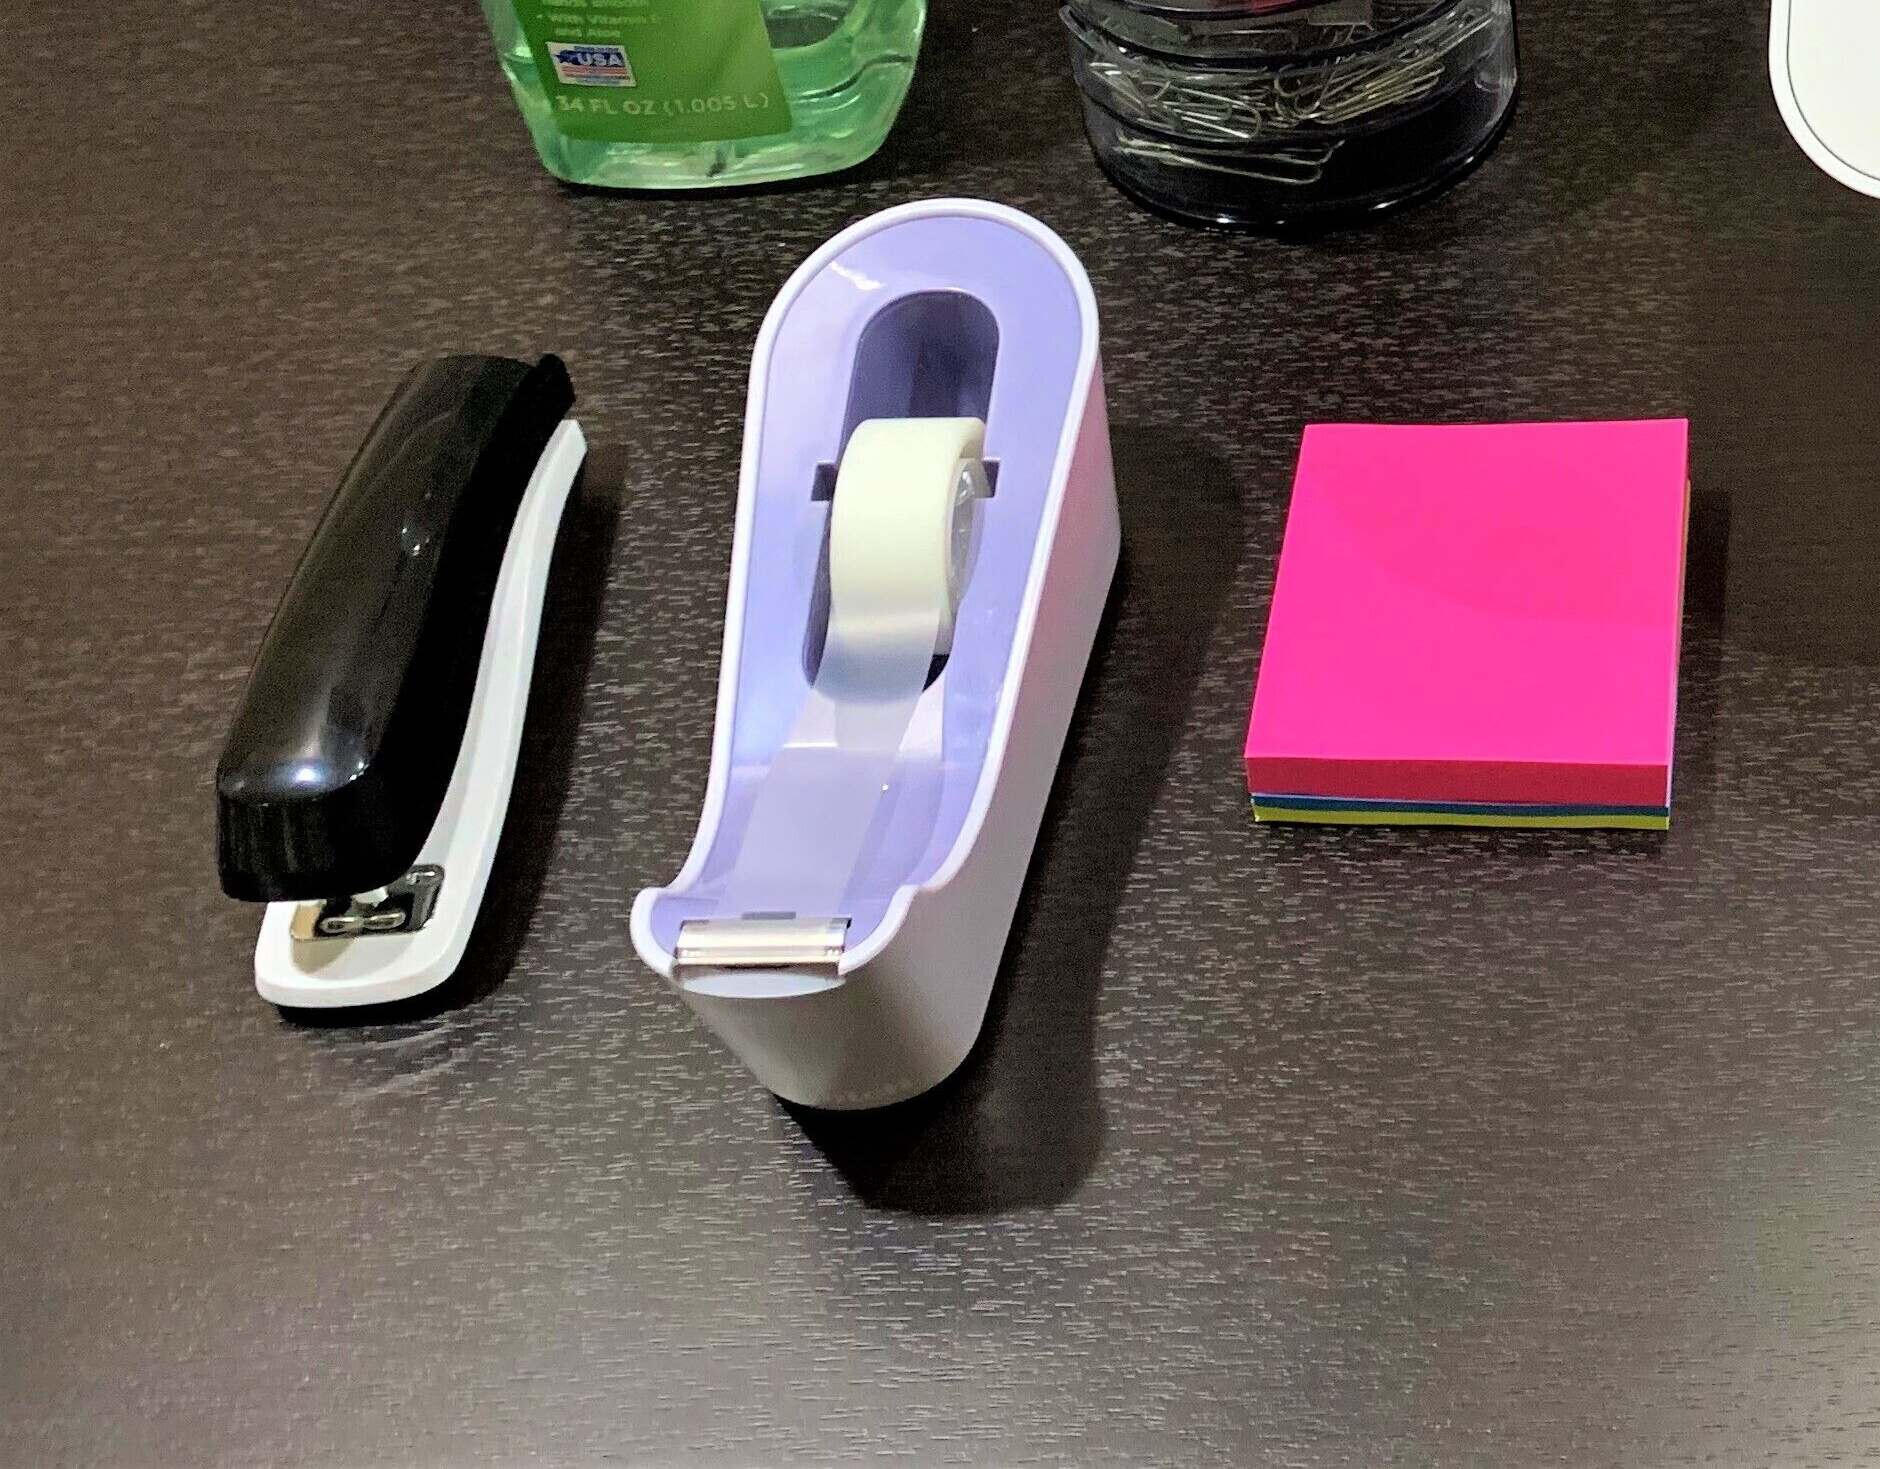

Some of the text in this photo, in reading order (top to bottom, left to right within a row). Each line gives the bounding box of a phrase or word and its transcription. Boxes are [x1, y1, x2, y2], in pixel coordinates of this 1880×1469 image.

[576, 52, 623, 67] USA
[555, 91, 770, 117] 34 FL OZ (1.005 L)
